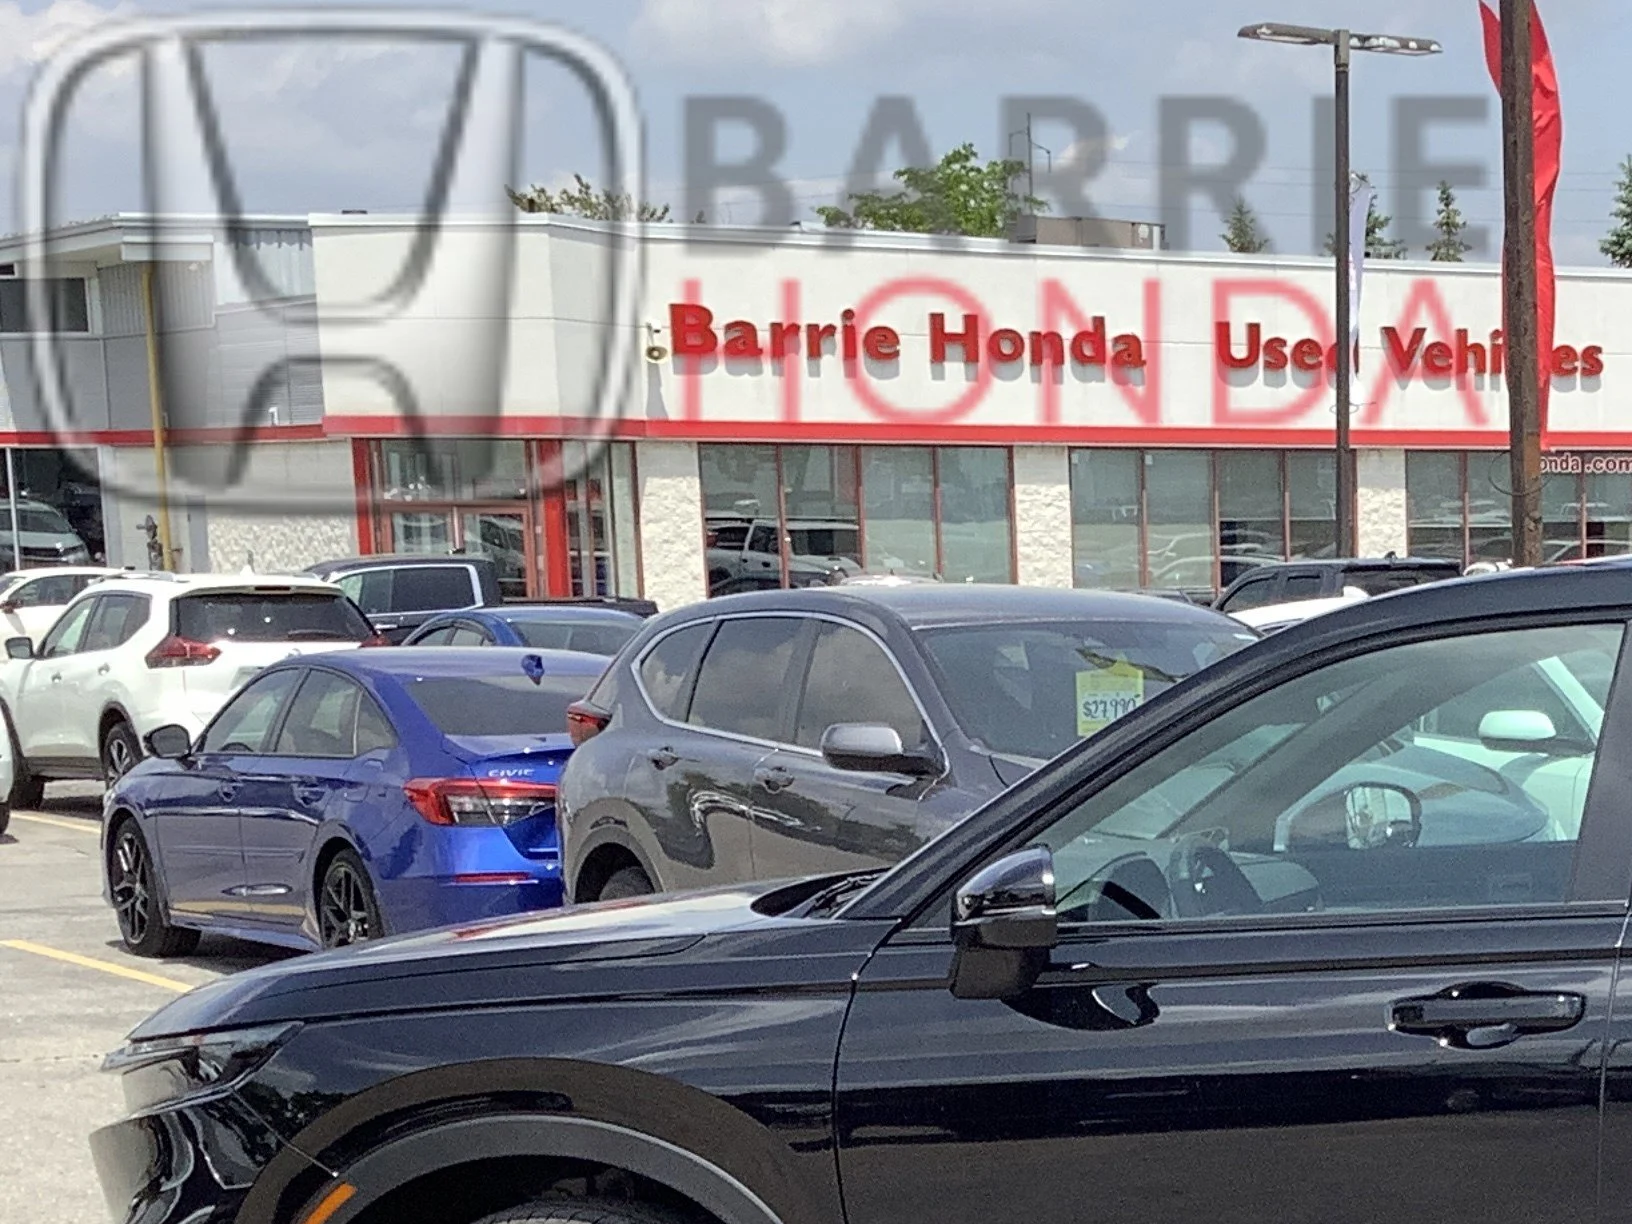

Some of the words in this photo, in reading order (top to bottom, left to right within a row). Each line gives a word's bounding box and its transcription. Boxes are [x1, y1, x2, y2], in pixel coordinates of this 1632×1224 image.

[669, 302, 900, 361] Barrie
[929, 312, 1147, 368] Honda
[1381, 327, 1604, 376] Vehies
